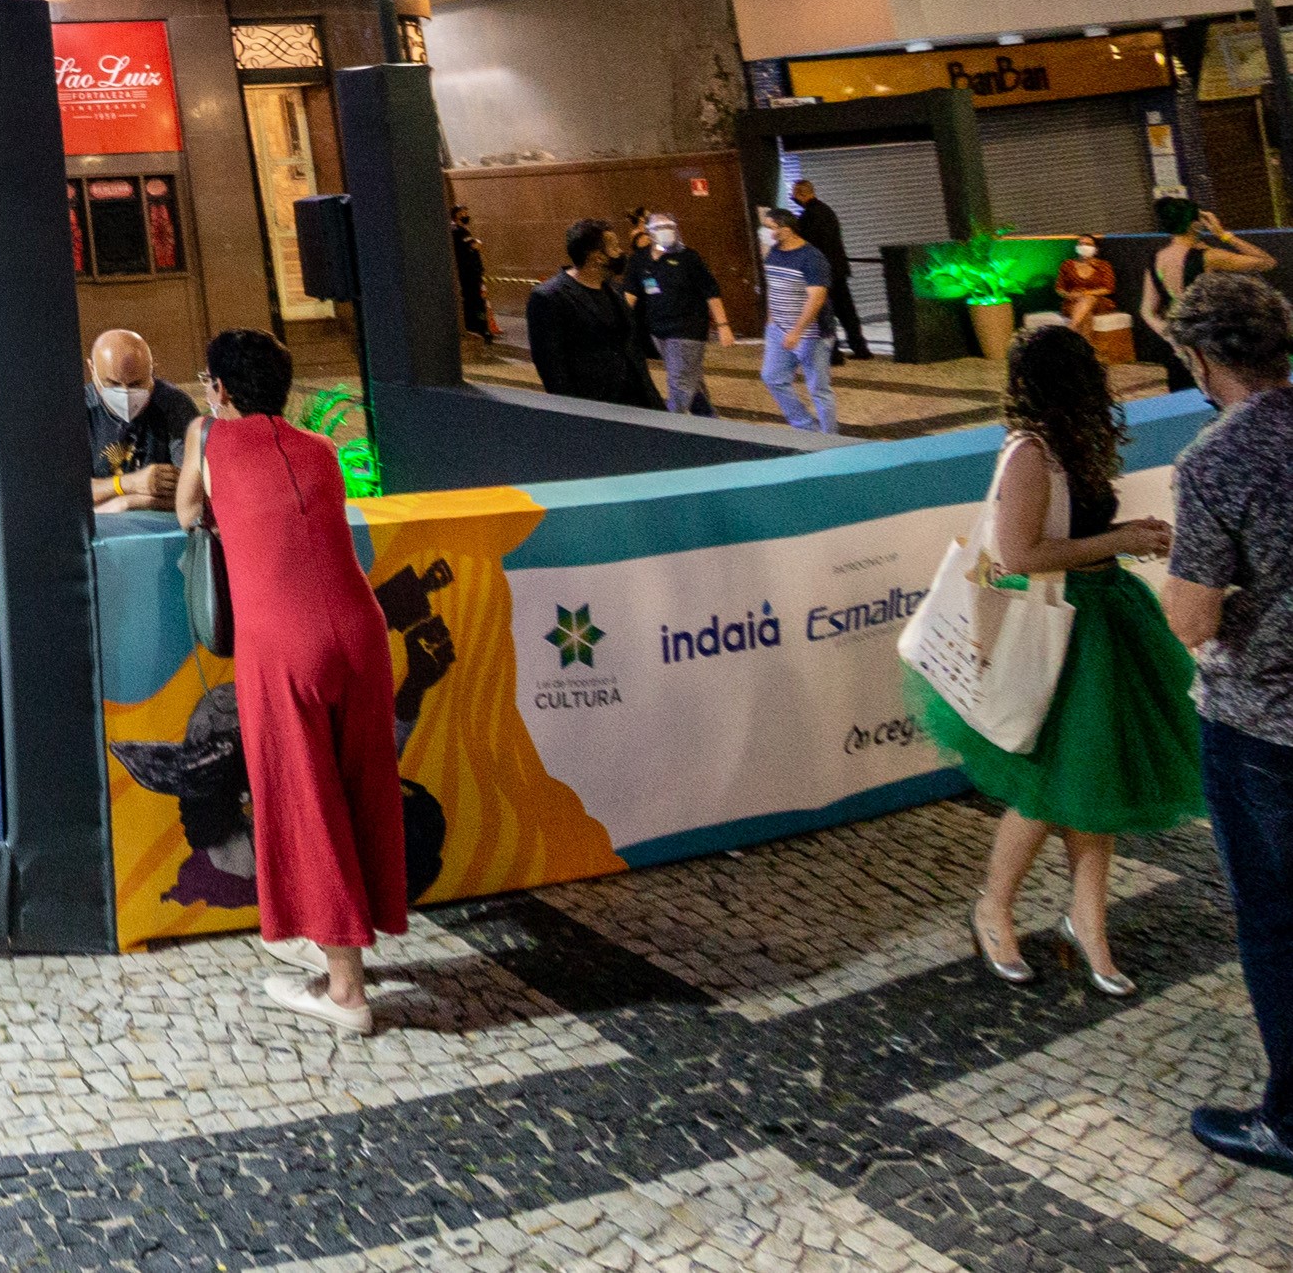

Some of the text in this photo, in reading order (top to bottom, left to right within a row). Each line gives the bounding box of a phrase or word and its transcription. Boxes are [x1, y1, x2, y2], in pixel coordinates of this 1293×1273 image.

[97, 54, 163, 87] Luiz
[71, 90, 131, 100] FORTALEZA
[807, 586, 931, 642] Esmalte
[534, 686, 623, 710] CULTURA
